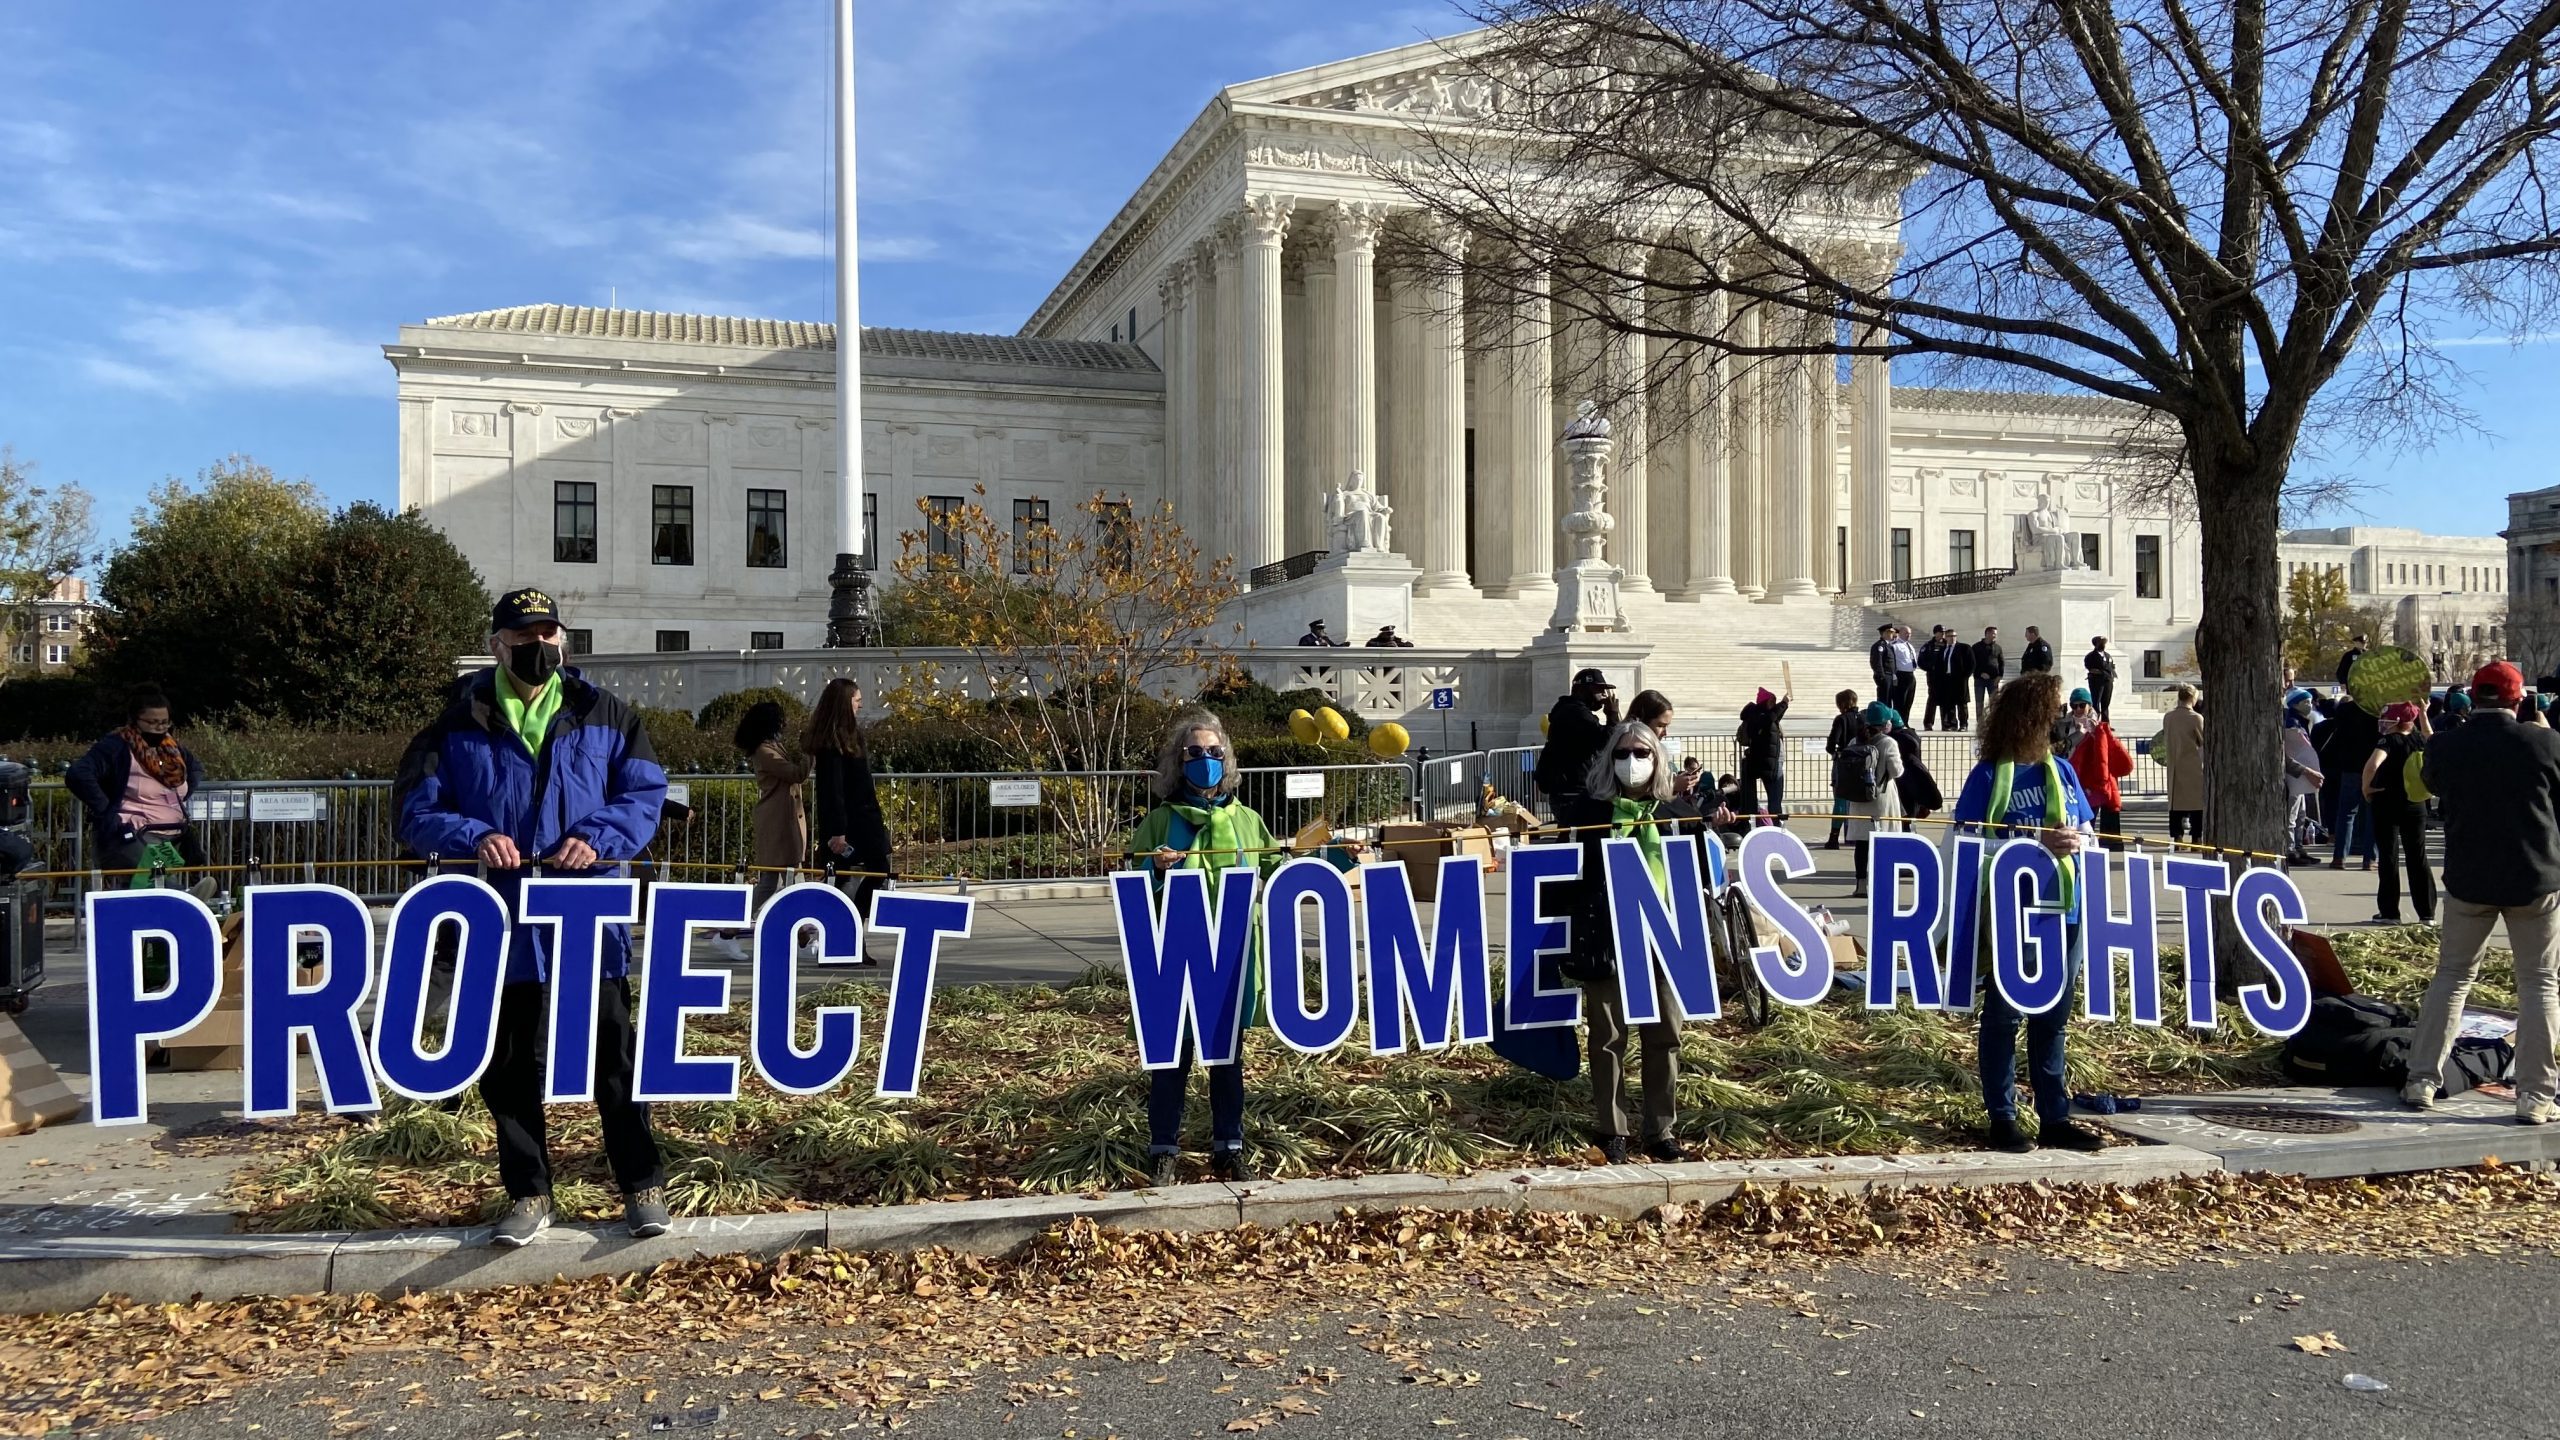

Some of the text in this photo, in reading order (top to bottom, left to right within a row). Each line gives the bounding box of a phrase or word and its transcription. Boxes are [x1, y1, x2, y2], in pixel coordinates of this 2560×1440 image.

[530, 591, 552, 605] NAVY
[2354, 659, 2424, 687] Abortion
[2360, 651, 2402, 671] Grow
[2372, 670, 2426, 694] Power
[85, 874, 975, 1126] PROTECT
[1866, 832, 2312, 1037] RIGHTS
